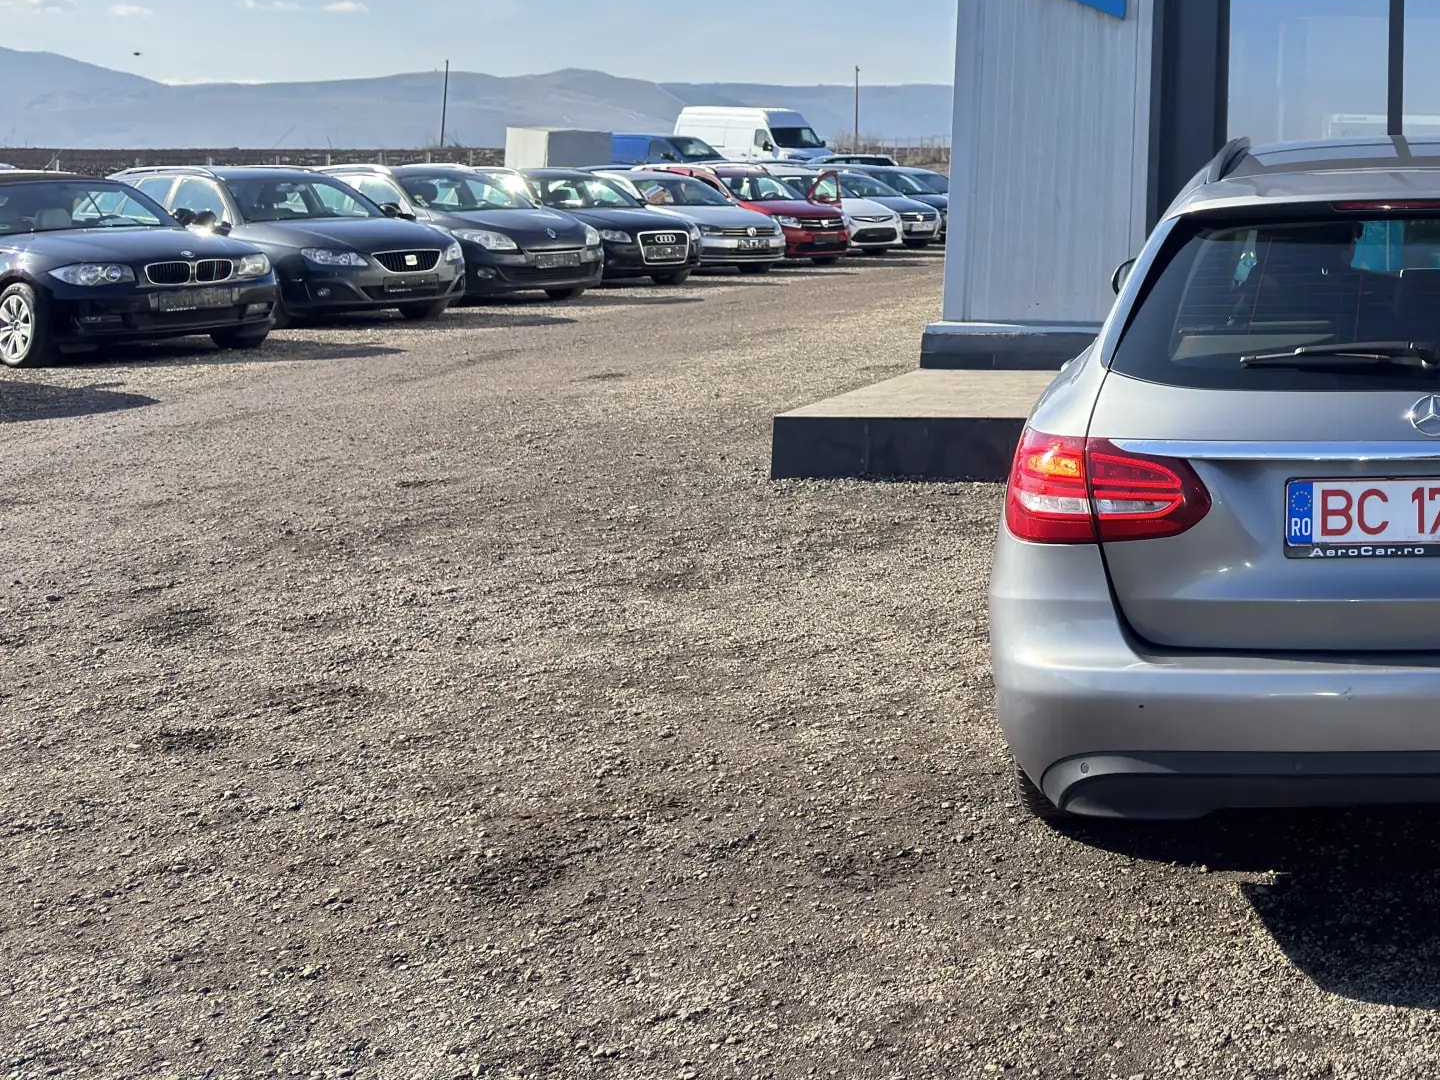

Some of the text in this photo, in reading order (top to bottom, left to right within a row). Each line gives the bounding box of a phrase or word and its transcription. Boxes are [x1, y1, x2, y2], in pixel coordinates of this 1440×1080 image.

[1321, 488, 1389, 536] BC
[1291, 517, 1311, 537] RO
[1308, 546, 1425, 558] AeroCar.ro
